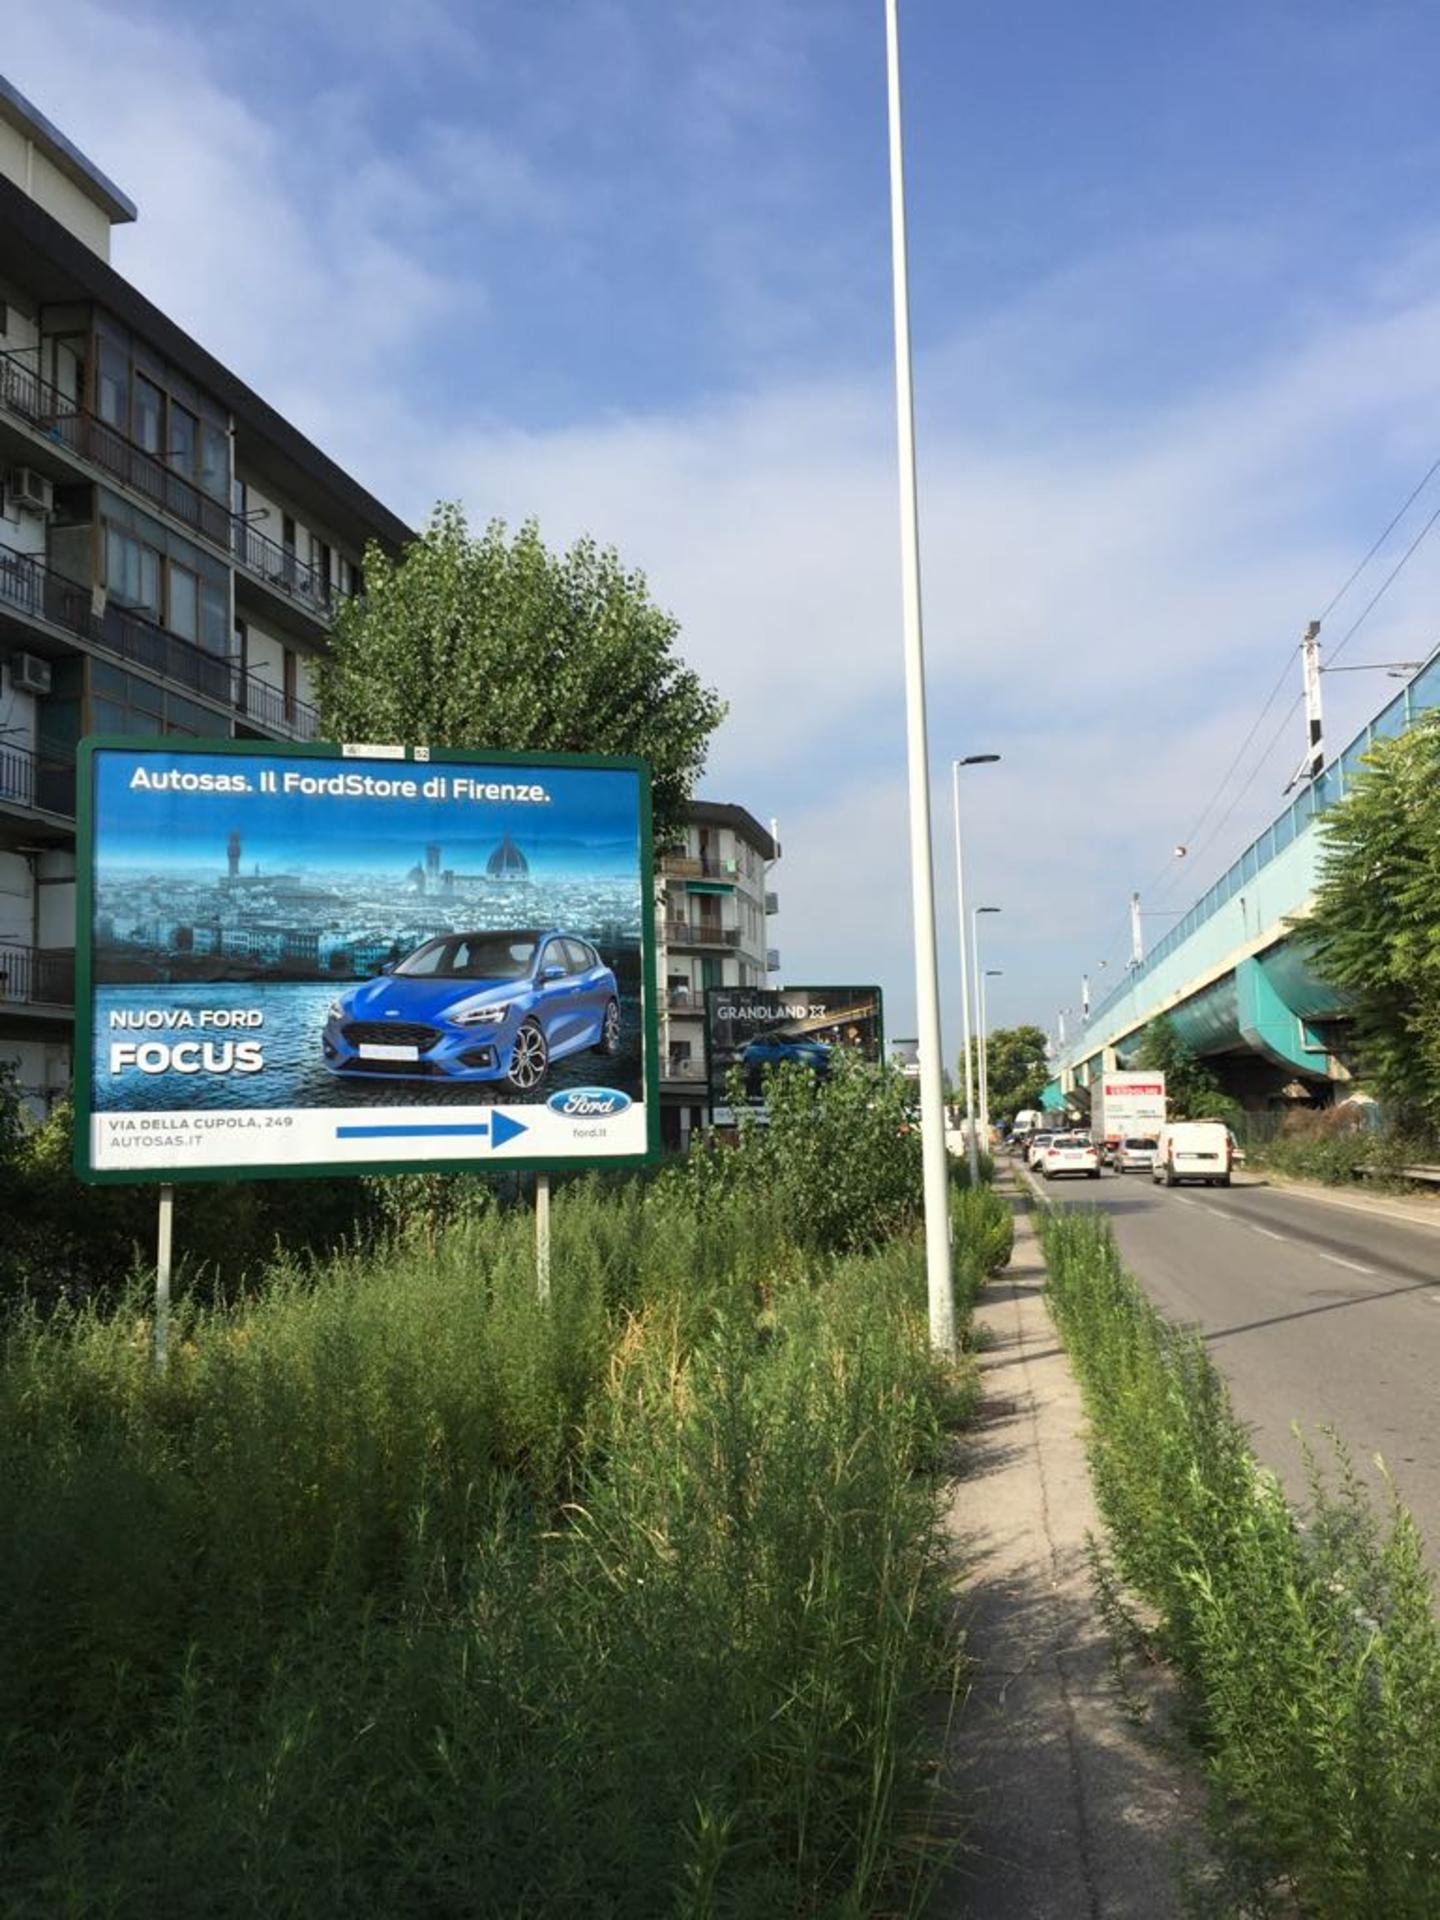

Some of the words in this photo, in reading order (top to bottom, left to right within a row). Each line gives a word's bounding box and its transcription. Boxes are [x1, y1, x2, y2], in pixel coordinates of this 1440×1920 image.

[130, 767, 253, 792] Autosas.
[284, 773, 417, 797] FordStore
[423, 777, 446, 798] di
[453, 779, 551, 802] Firenze.
[110, 1010, 194, 1028] NUOVA
[200, 1010, 263, 1028] FORD
[718, 1005, 806, 1019] GRANDLAND
[110, 1041, 264, 1074] FOCUS
[563, 1092, 615, 1114] Ford
[109, 1119, 137, 1131] VIA
[140, 1118, 190, 1130] DELLA
[193, 1117, 262, 1129] CUPOLA,
[265, 1116, 294, 1128] 249
[110, 1135, 203, 1148] AUTOSAS.IT
